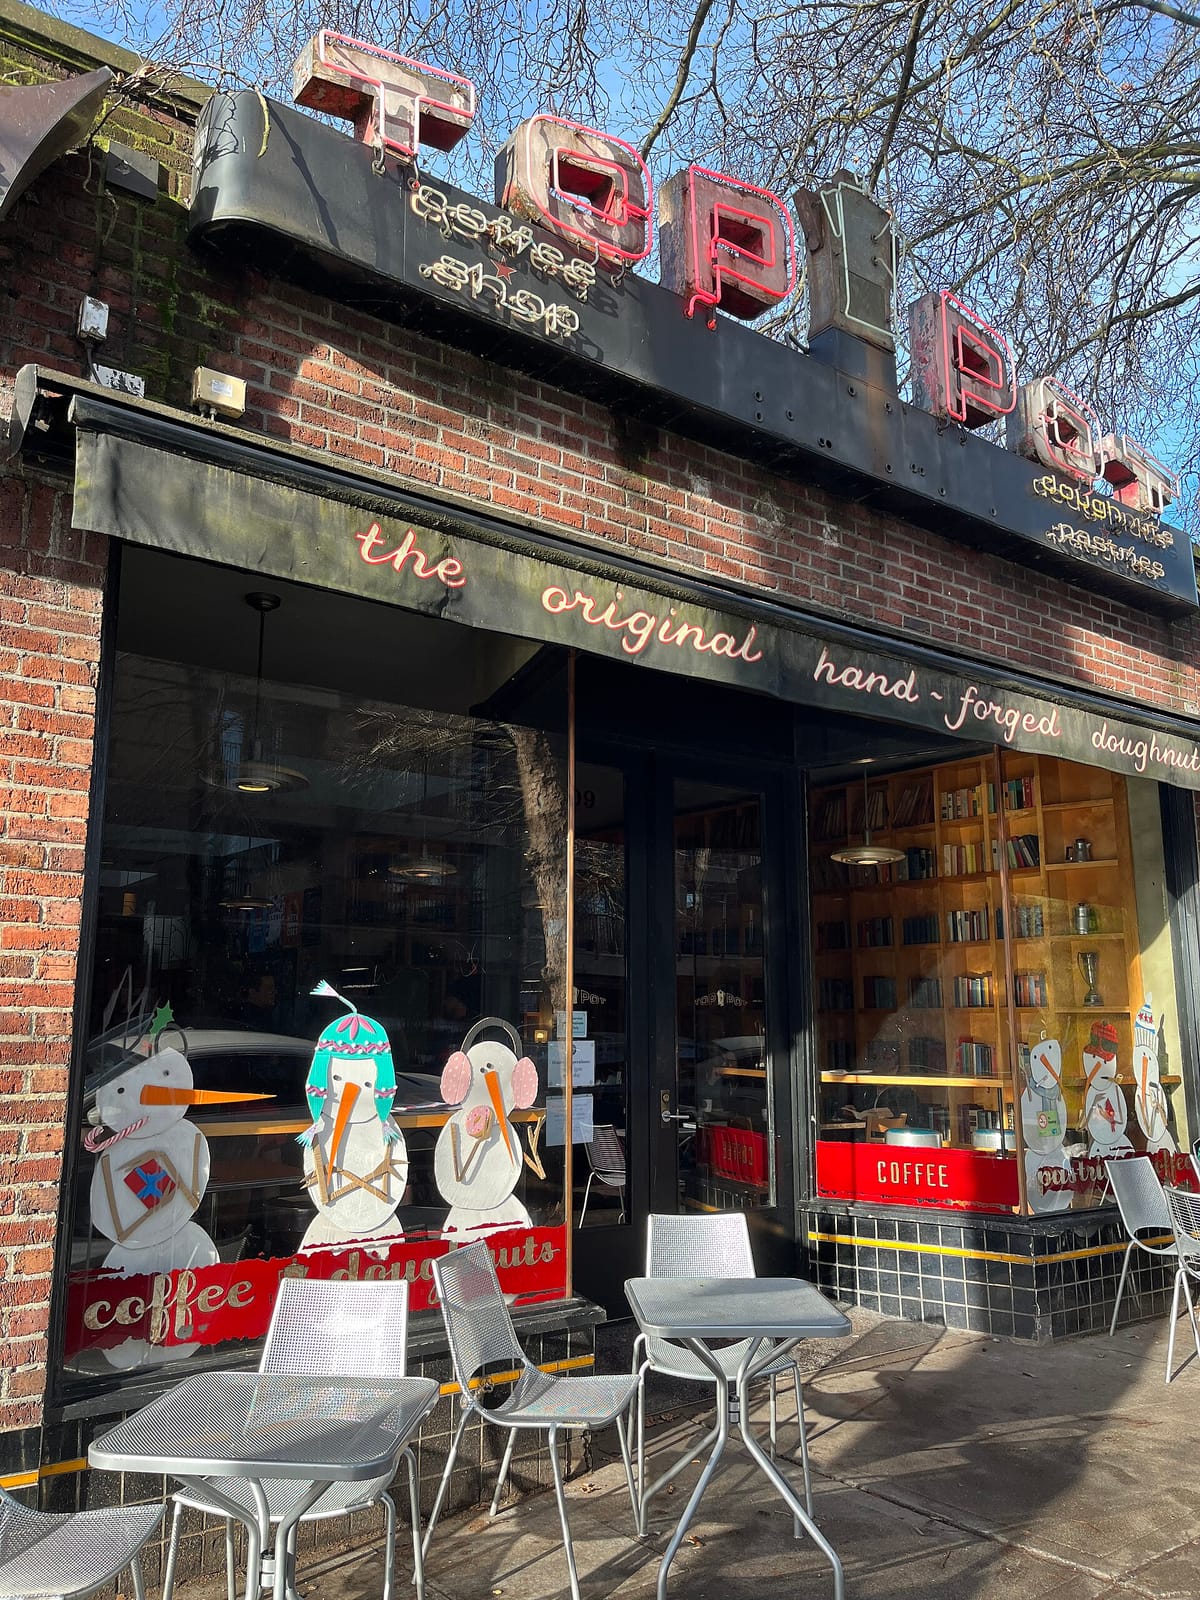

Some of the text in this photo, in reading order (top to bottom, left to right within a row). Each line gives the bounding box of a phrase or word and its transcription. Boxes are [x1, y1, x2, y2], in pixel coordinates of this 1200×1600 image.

[293, 28, 1181, 515] TOP POT
[1045, 522, 1166, 580] pastries
[354, 521, 468, 590] the
[541, 585, 764, 663] original
[812, 646, 920, 704] hand
[943, 684, 1063, 744] forged
[876, 1160, 949, 1188] COFFEE
[1036, 1156, 1109, 1196] pastri
[83, 1269, 256, 1344] coffee
